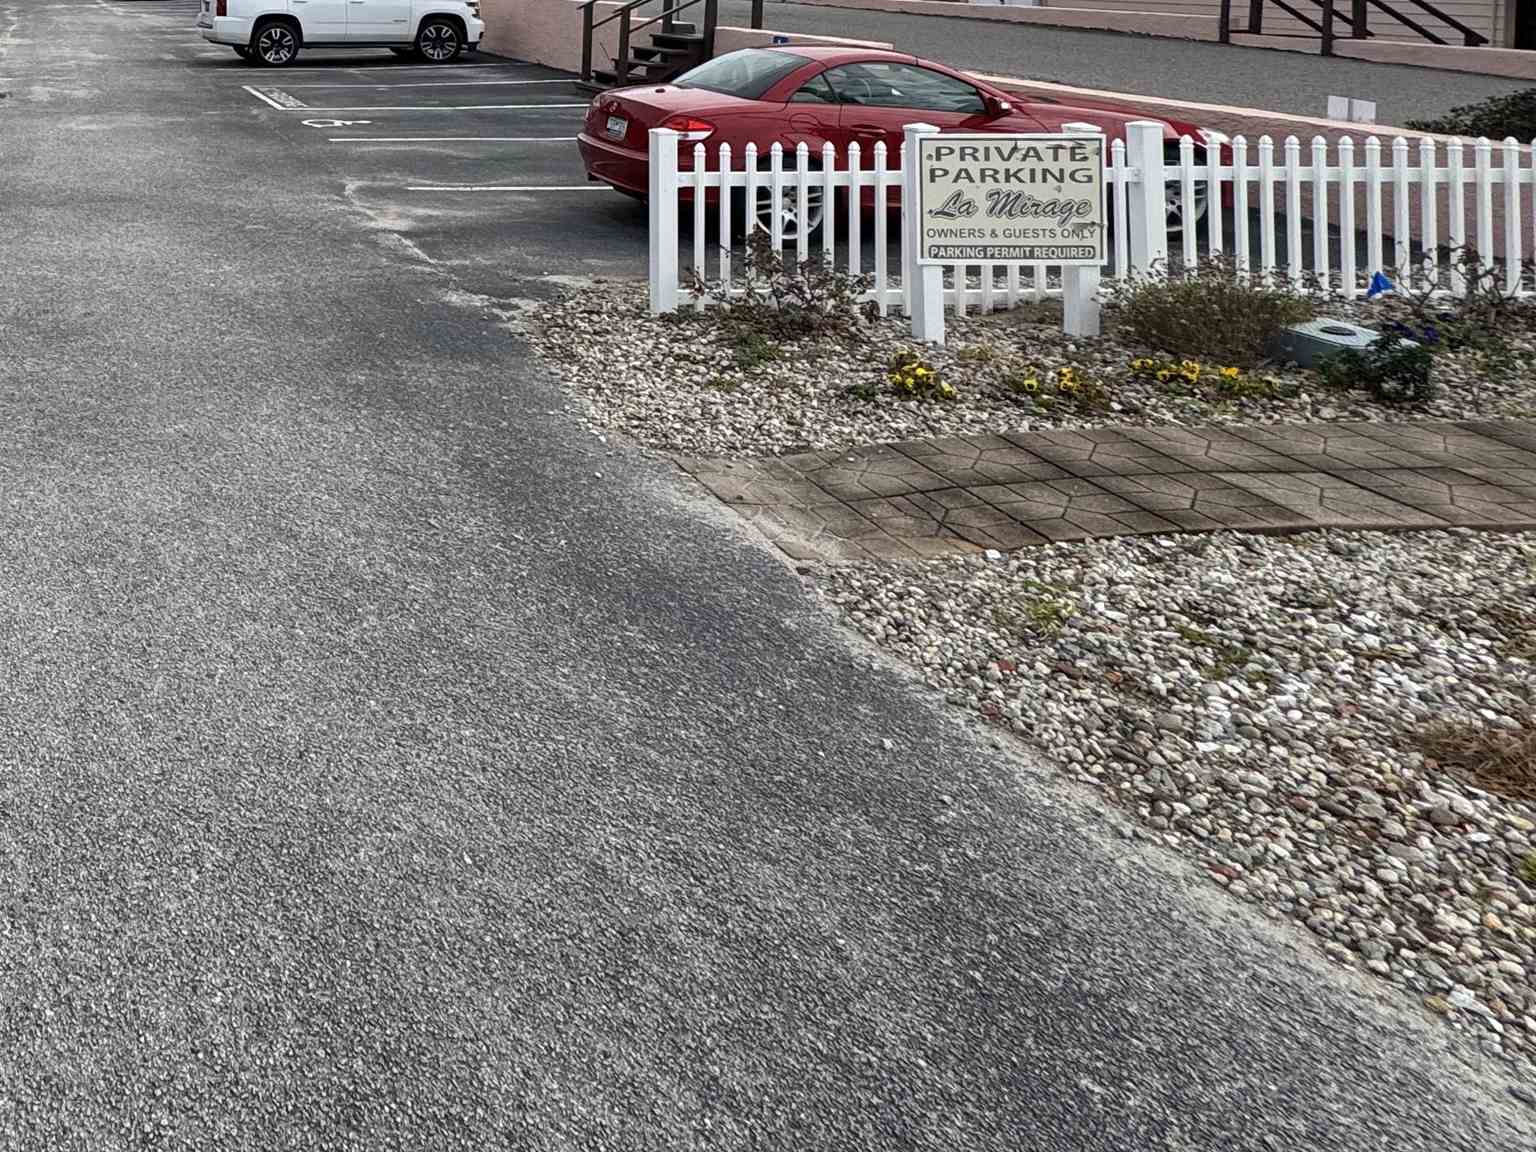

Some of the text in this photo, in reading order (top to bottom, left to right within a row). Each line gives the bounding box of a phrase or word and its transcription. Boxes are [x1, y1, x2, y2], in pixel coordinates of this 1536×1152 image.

[934, 145, 1091, 162] PRIVATE
[929, 167, 1094, 184] PARKING
[929, 187, 1093, 228] La Mirage
[926, 228, 1097, 240] OWNERS & GUESTS ONLY
[930, 247, 1095, 259] PARKING PERMIT REQUIRED
